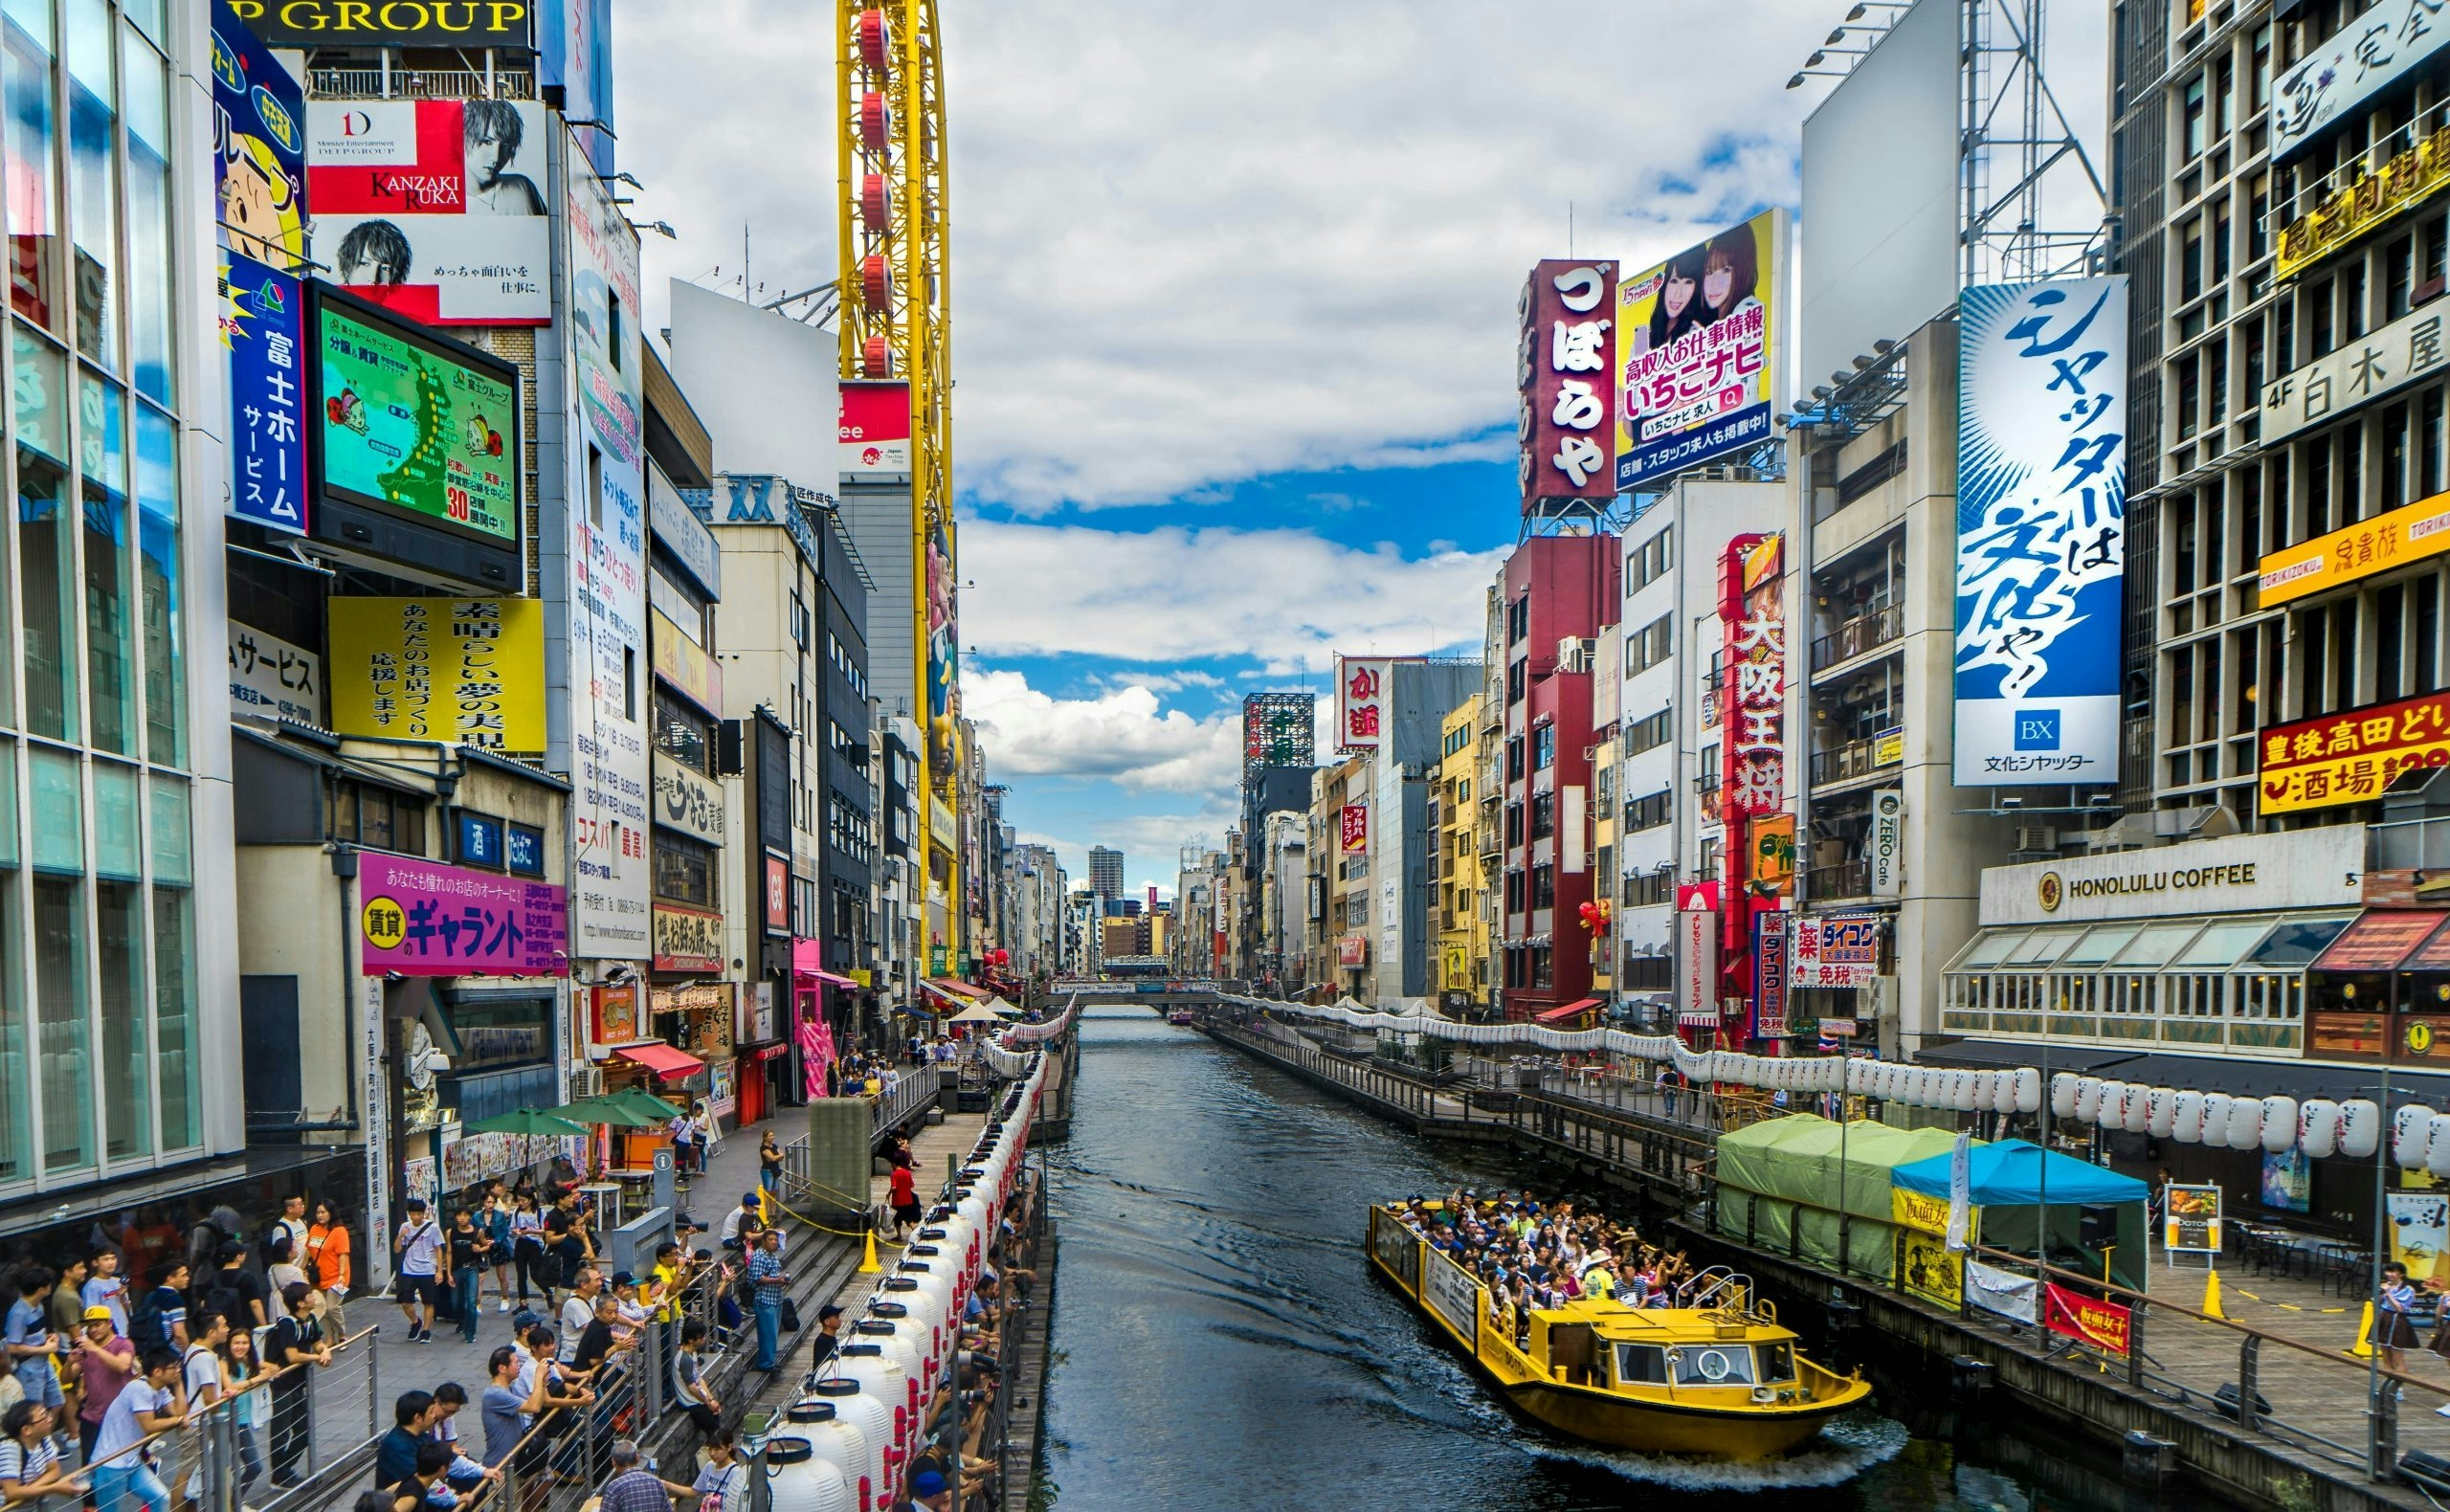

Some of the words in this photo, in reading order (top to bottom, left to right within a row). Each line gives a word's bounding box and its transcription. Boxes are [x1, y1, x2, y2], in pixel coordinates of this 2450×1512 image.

[279, 1, 525, 32] GROUP
[318, 139, 344, 147] Monster
[370, 171, 459, 198] KANZAKI
[405, 189, 459, 211] RUKA
[434, 265, 528, 278] めっちゃ面白いを
[501, 281, 542, 295] 仕事に。
[340, 323, 395, 354] 富士ホームサービス
[1625, 304, 1764, 385] 高収入お仕事情報
[1624, 332, 1764, 419] いちごナビ
[2266, 377, 2294, 411] 4F
[2304, 314, 2444, 424] 白木屋
[265, 329, 298, 521] 富士ホーム
[1643, 406, 1692, 437] いちごナビ
[1693, 399, 1714, 419] 求人
[243, 404, 264, 504] サービス
[1619, 410, 1768, 479] 店舗・スタッフ求人も掲載中!
[446, 487, 468, 522] 30
[469, 495, 486, 511] 店舗
[2260, 563, 2317, 590] TORIKIZOKU
[402, 603, 433, 737] あなたのお店づくり
[452, 601, 505, 750] 素晴らしい夢の実現
[369, 652, 399, 727] 応援します
[1734, 609, 1785, 813] 大阪王将
[2019, 720, 2055, 741] BX
[1984, 756, 2096, 774] 文化シャッター
[2292, 759, 2378, 802] 酒場
[1344, 812, 1354, 844] ドラッグ
[1353, 808, 1365, 837] ツルハ
[1879, 817, 1894, 857] ZERO
[472, 823, 484, 857] 酒
[508, 832, 533, 866] たばこ
[622, 826, 647, 860] 最高!
[386, 867, 522, 903] あなたも憧れのお店のオーナーに!
[2069, 870, 2169, 899] HONOLULU
[2172, 861, 2257, 889] COFFEE
[368, 907, 402, 939] 賃貸
[407, 898, 524, 959] ギャラント
[670, 913, 706, 955] お好み焼
[1763, 912, 1783, 933] 薬
[1822, 923, 1874, 948] ダイコク
[403, 942, 412, 956] の
[1798, 923, 1819, 961] 薬
[1763, 937, 1781, 989] ダイコク
[1818, 965, 1851, 985] 免税
[1850, 967, 1875, 975] Tax-Free
[1759, 1017, 1784, 1030] 免税
[2080, 1304, 2127, 1334] 仮面女子
